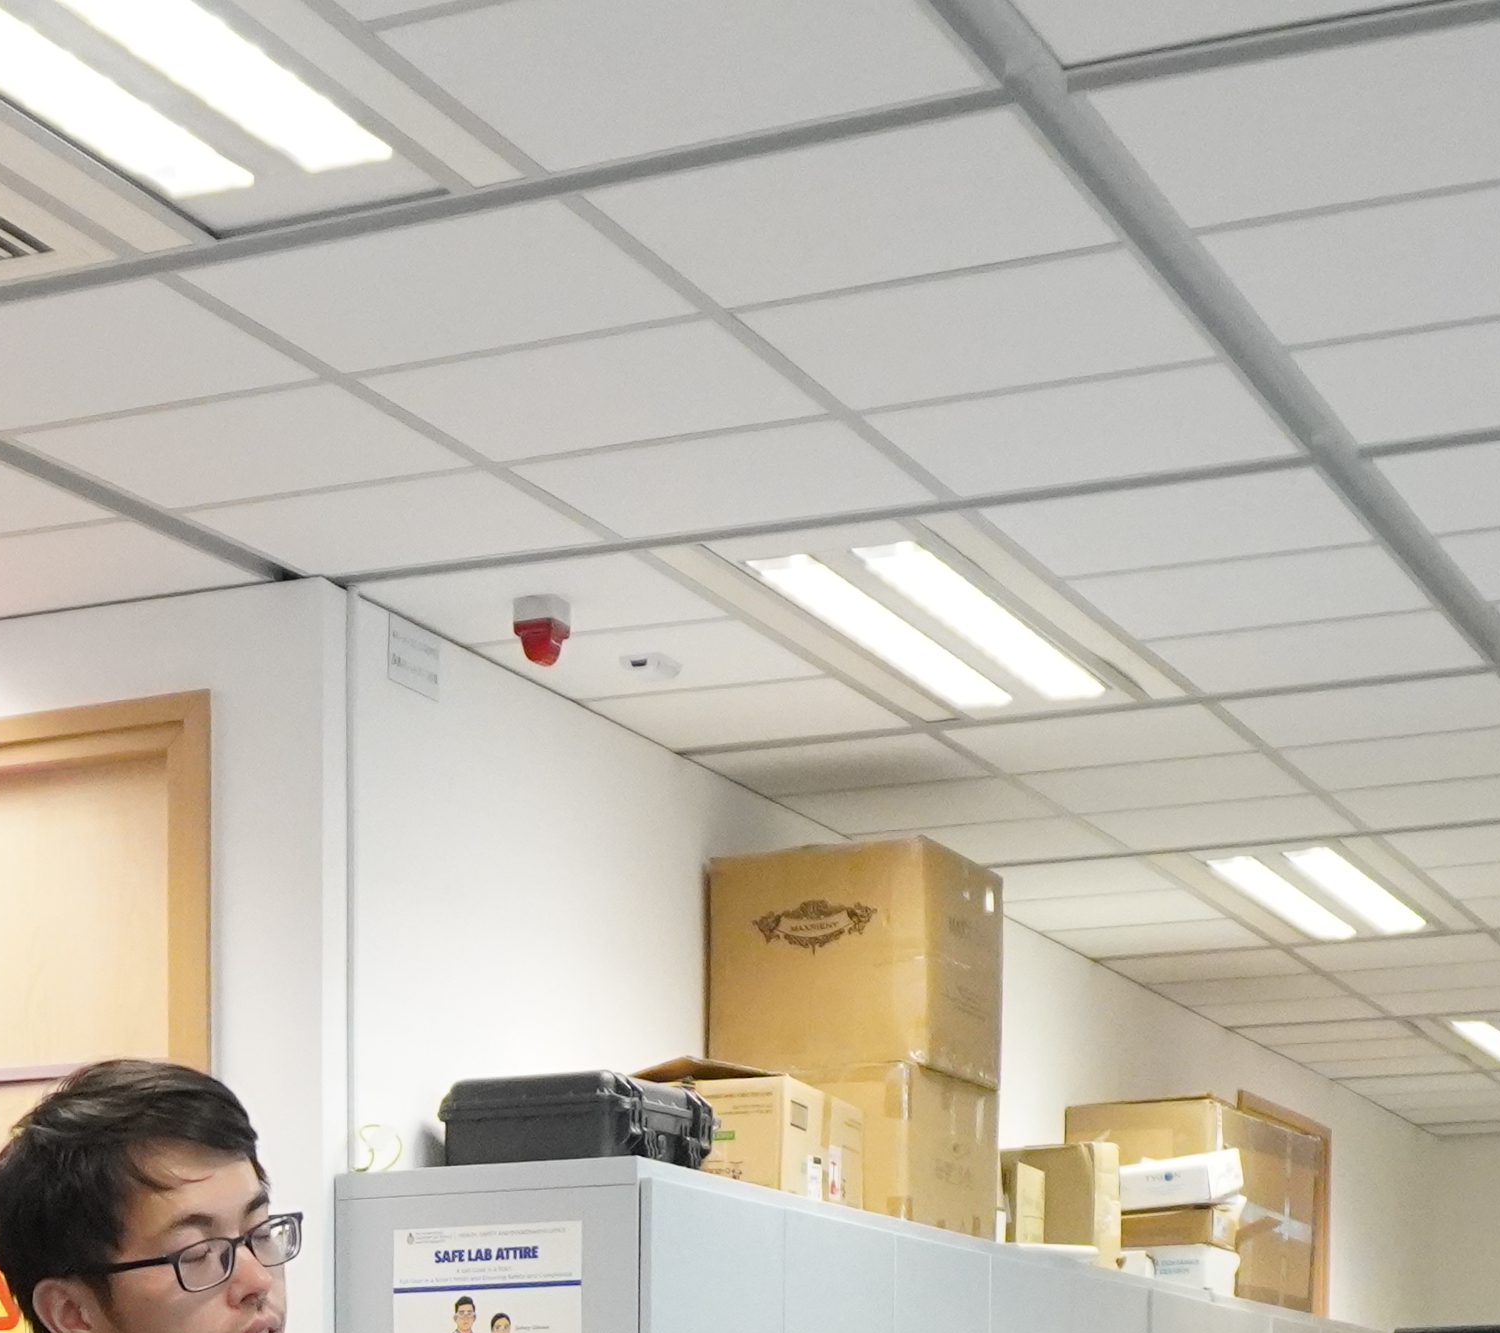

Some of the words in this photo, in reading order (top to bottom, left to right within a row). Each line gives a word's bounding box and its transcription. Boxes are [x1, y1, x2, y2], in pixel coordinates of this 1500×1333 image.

[434, 1249, 465, 1263] SAFE
[467, 1248, 493, 1262] LAB
[495, 1245, 539, 1260] ATTIRE
